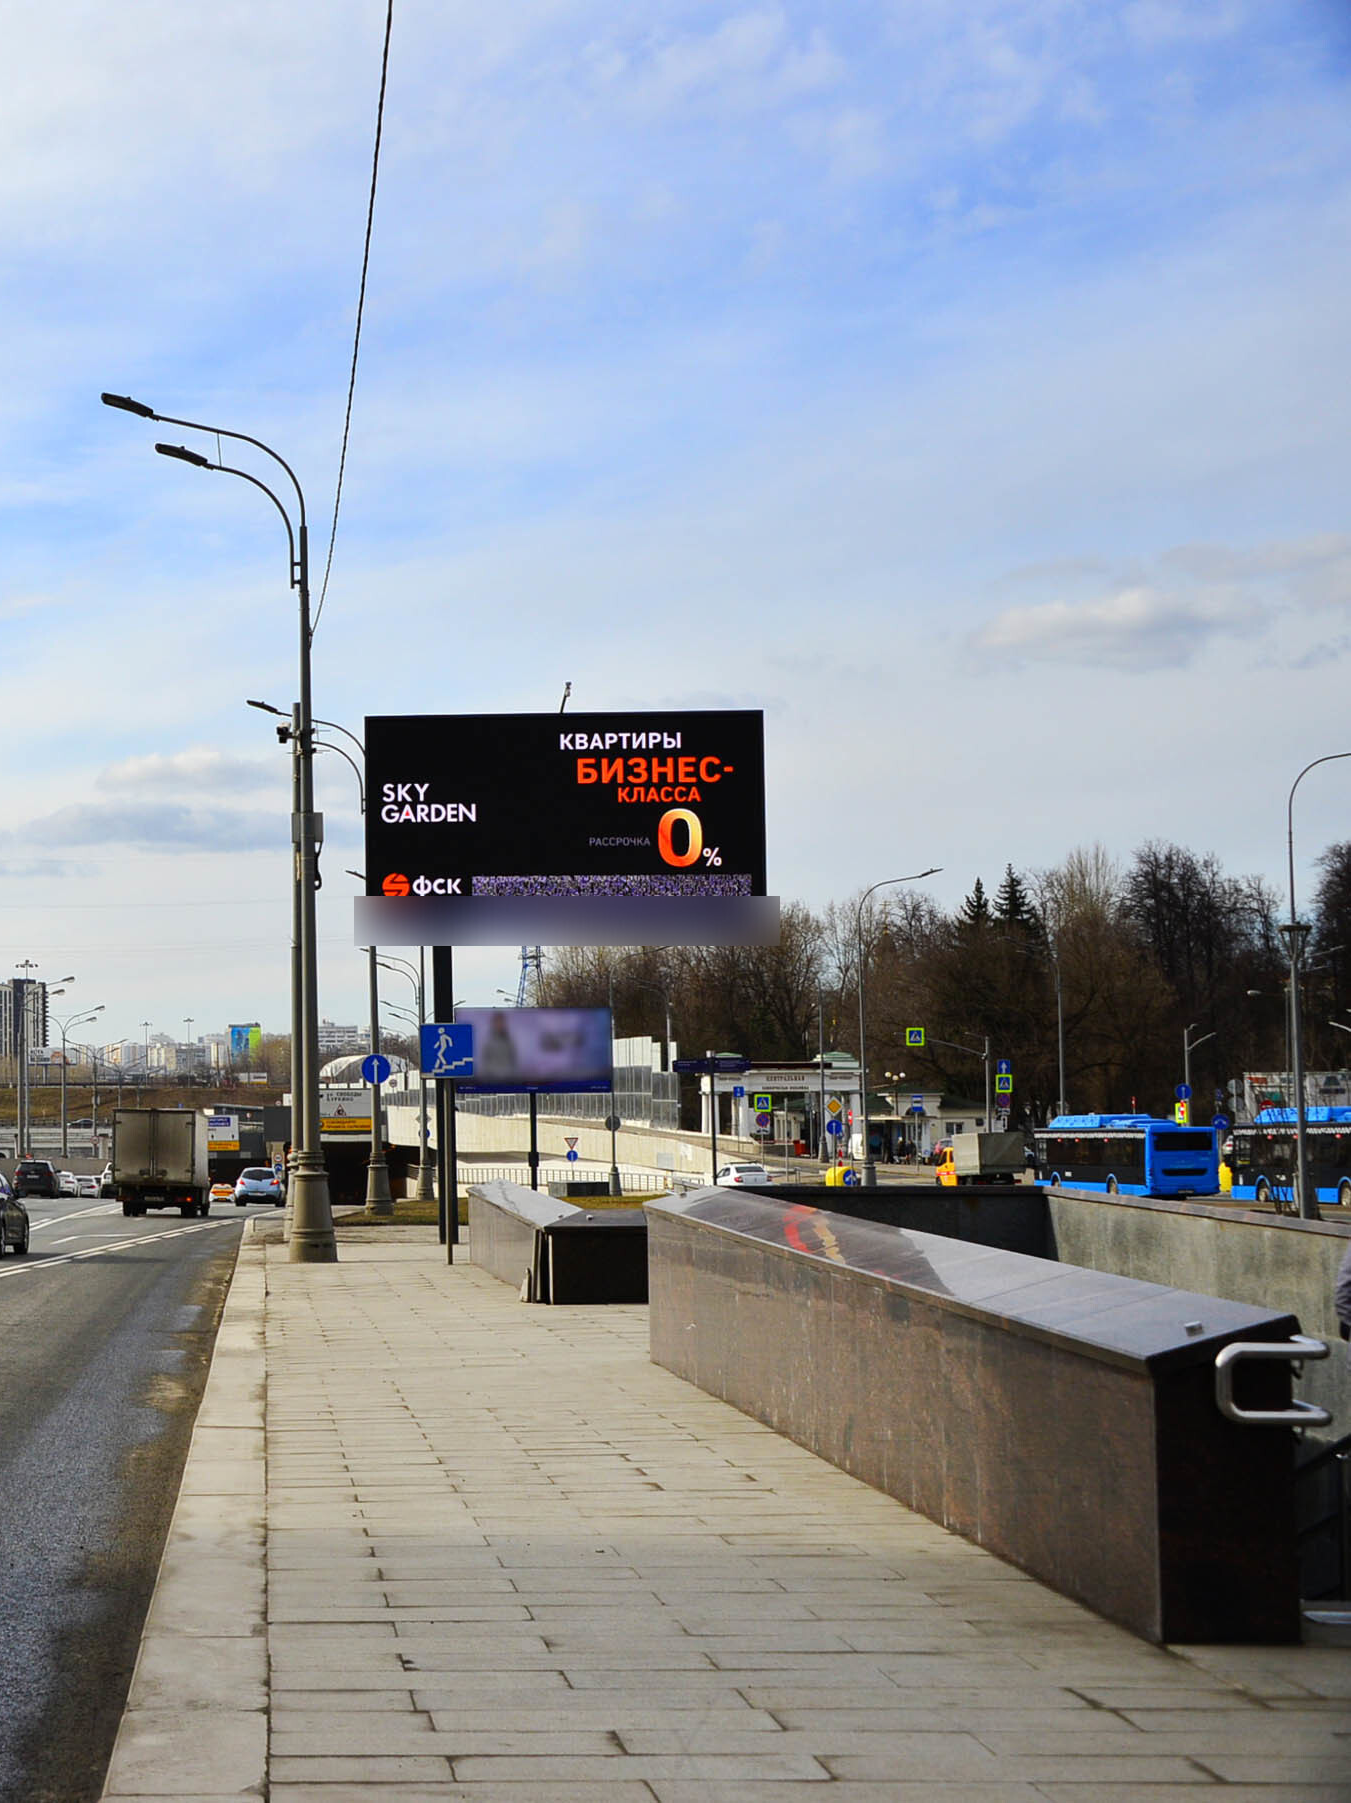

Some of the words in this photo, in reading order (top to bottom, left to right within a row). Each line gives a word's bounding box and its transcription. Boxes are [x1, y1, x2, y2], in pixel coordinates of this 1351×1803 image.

[559, 732, 682, 750] КВАРТИРЫ
[576, 757, 734, 784] БИЗНЕС-
[382, 783, 430, 803] SKY
[617, 786, 702, 803] КЛАССА
[381, 803, 477, 823] GARDEN
[588, 836, 651, 847] РАССРОЧКА
